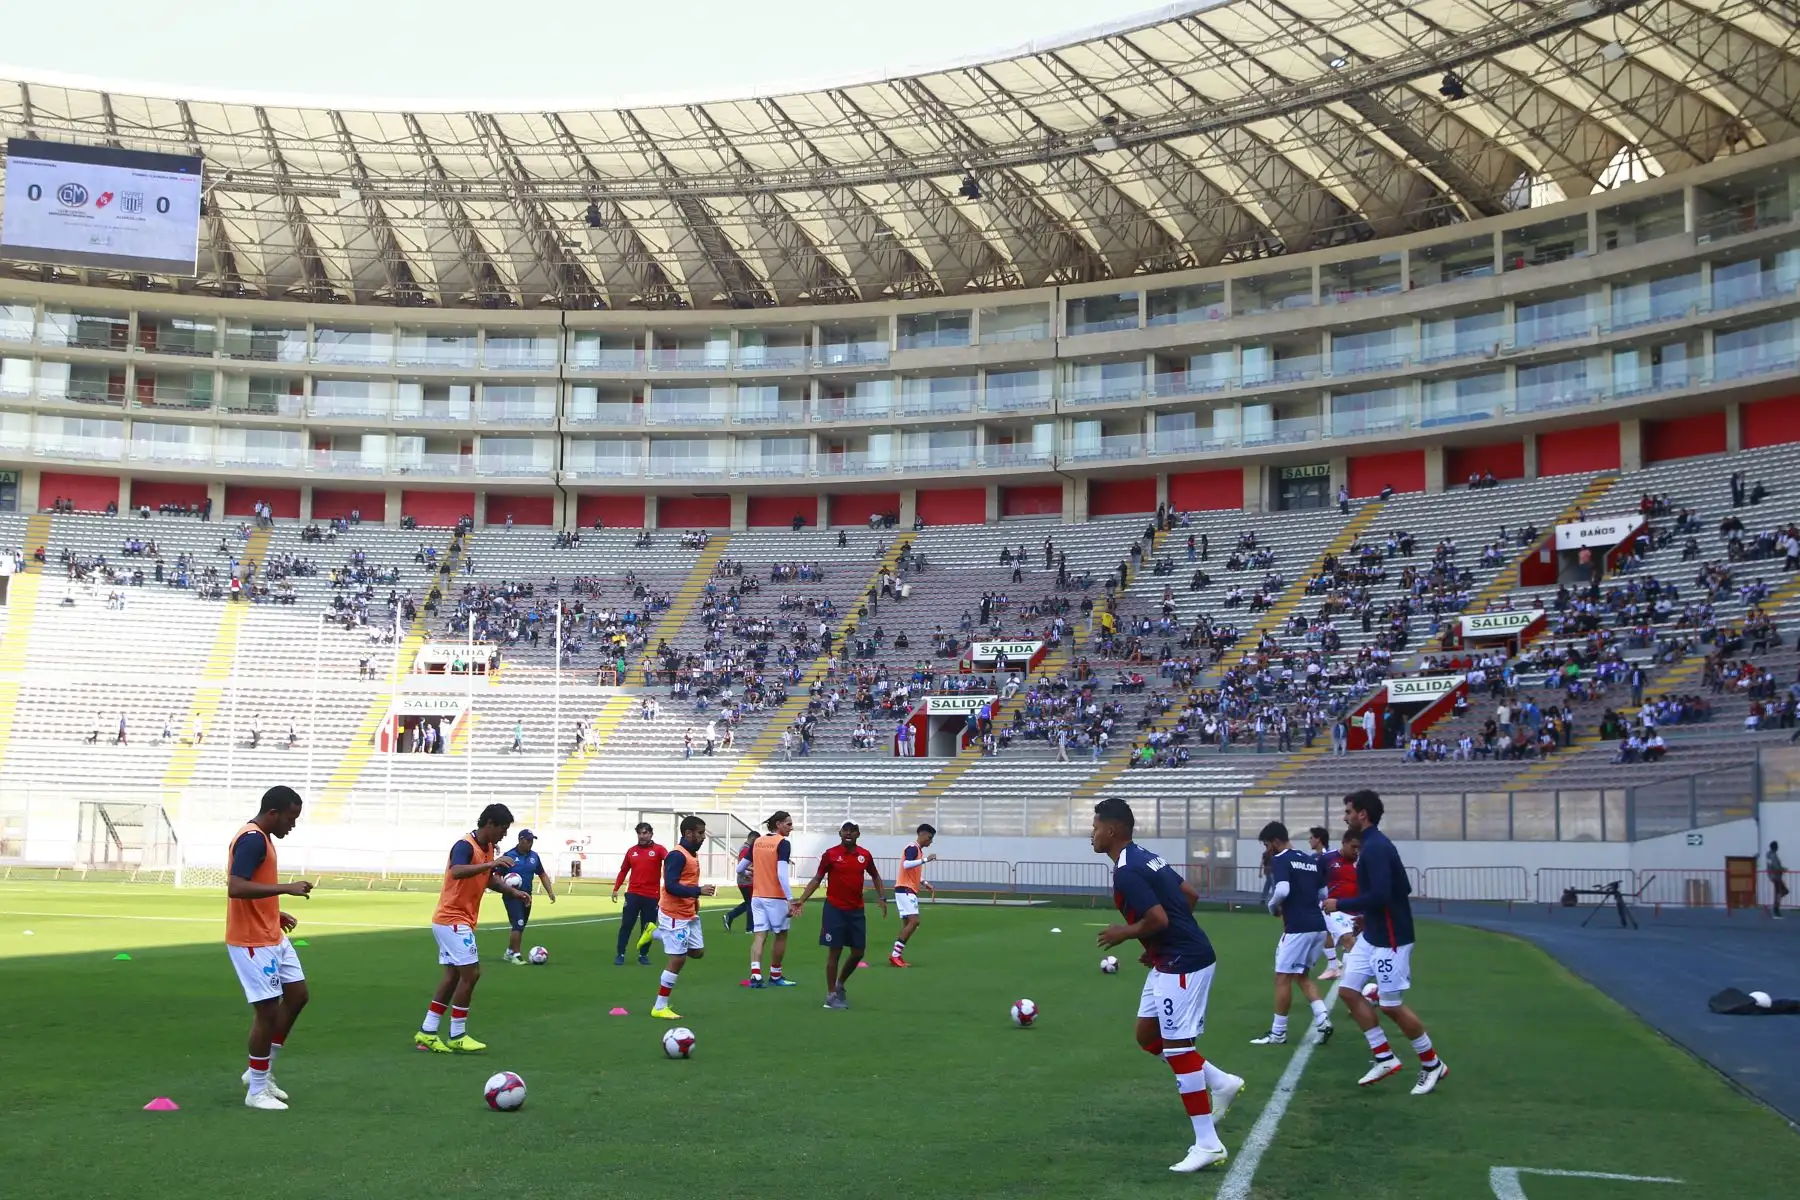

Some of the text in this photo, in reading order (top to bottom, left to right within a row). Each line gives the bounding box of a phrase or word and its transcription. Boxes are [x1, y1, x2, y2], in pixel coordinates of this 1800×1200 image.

[28, 184, 42, 201] 0
[156, 196, 171, 214] 0
[1580, 526, 1616, 537] BAÑOS
[1471, 615, 1531, 628] SALIDA
[981, 645, 1034, 654] SALIDA
[1394, 681, 1455, 693] SALIDA
[403, 700, 459, 708] SALIDA
[931, 699, 986, 708] SALIDA
[1290, 861, 1317, 872] WALON
[1377, 958, 1393, 973] 25
[1163, 997, 1174, 1016] 3
